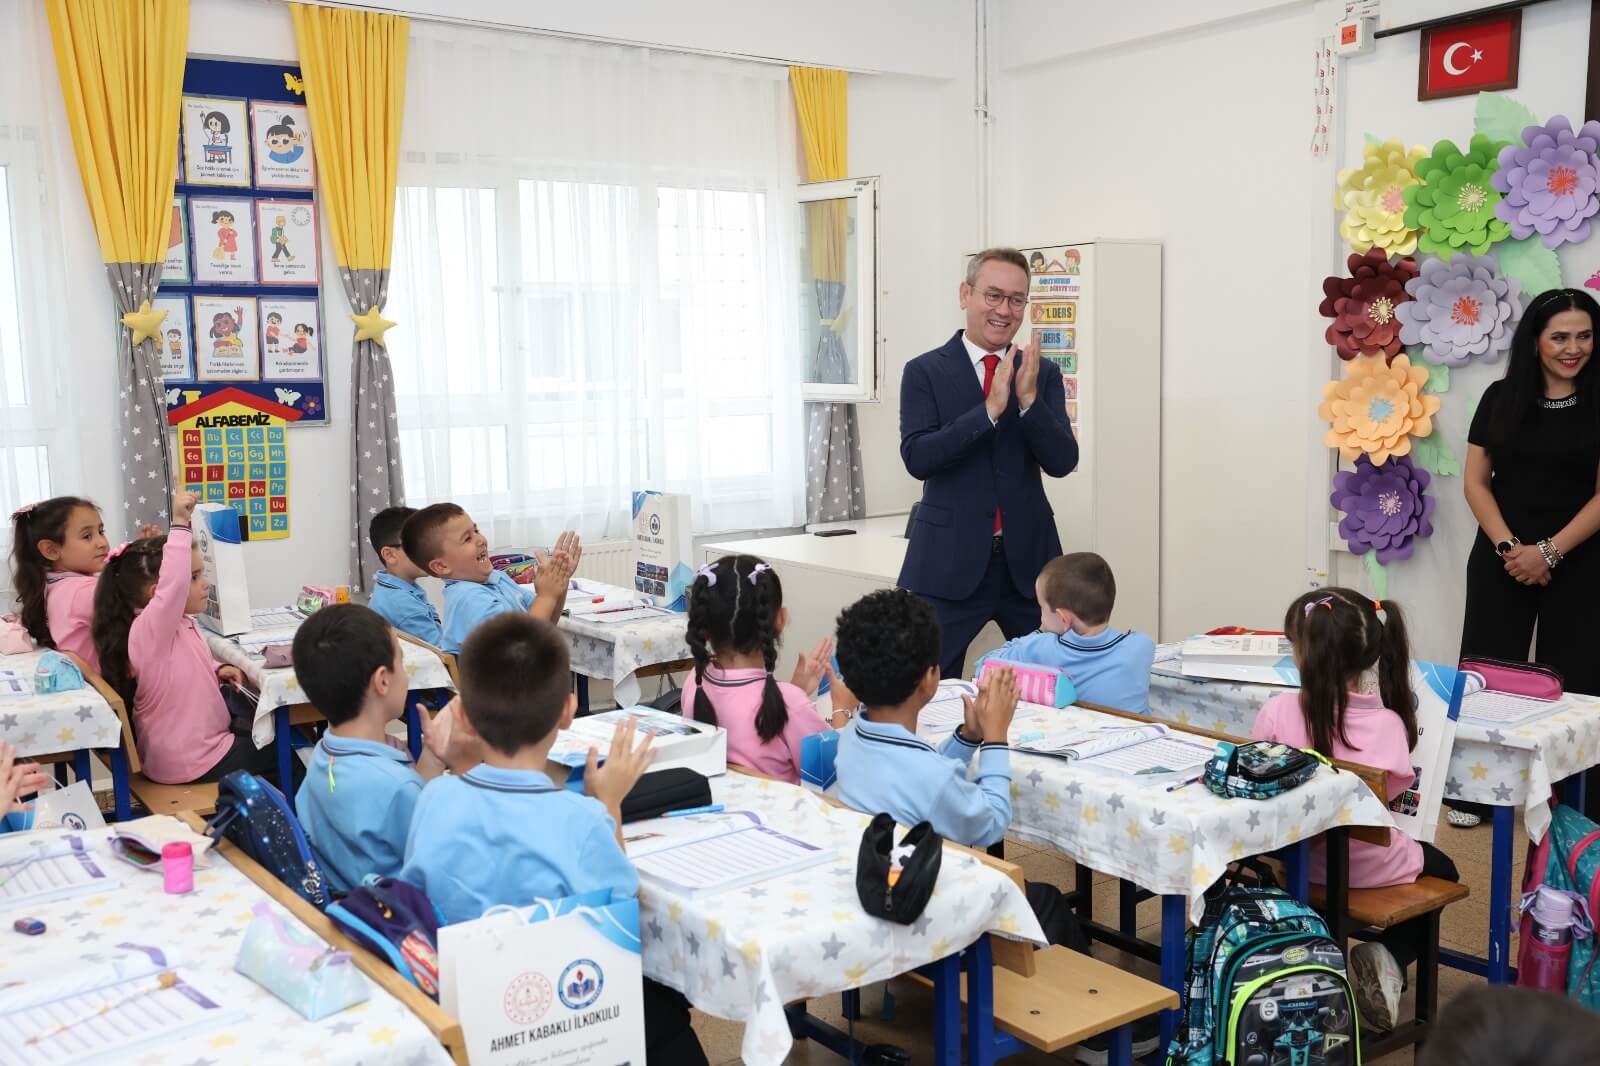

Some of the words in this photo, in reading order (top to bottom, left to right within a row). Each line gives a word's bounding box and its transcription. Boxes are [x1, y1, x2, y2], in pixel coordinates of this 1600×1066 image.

[1052, 306, 1072, 318] DERS
[195, 412, 271, 428] ALFABEMİZ
[490, 1031, 526, 1053] AHMET
[528, 1018, 572, 1042] KABAKLI
[574, 1005, 620, 1030] İLKOKULU
